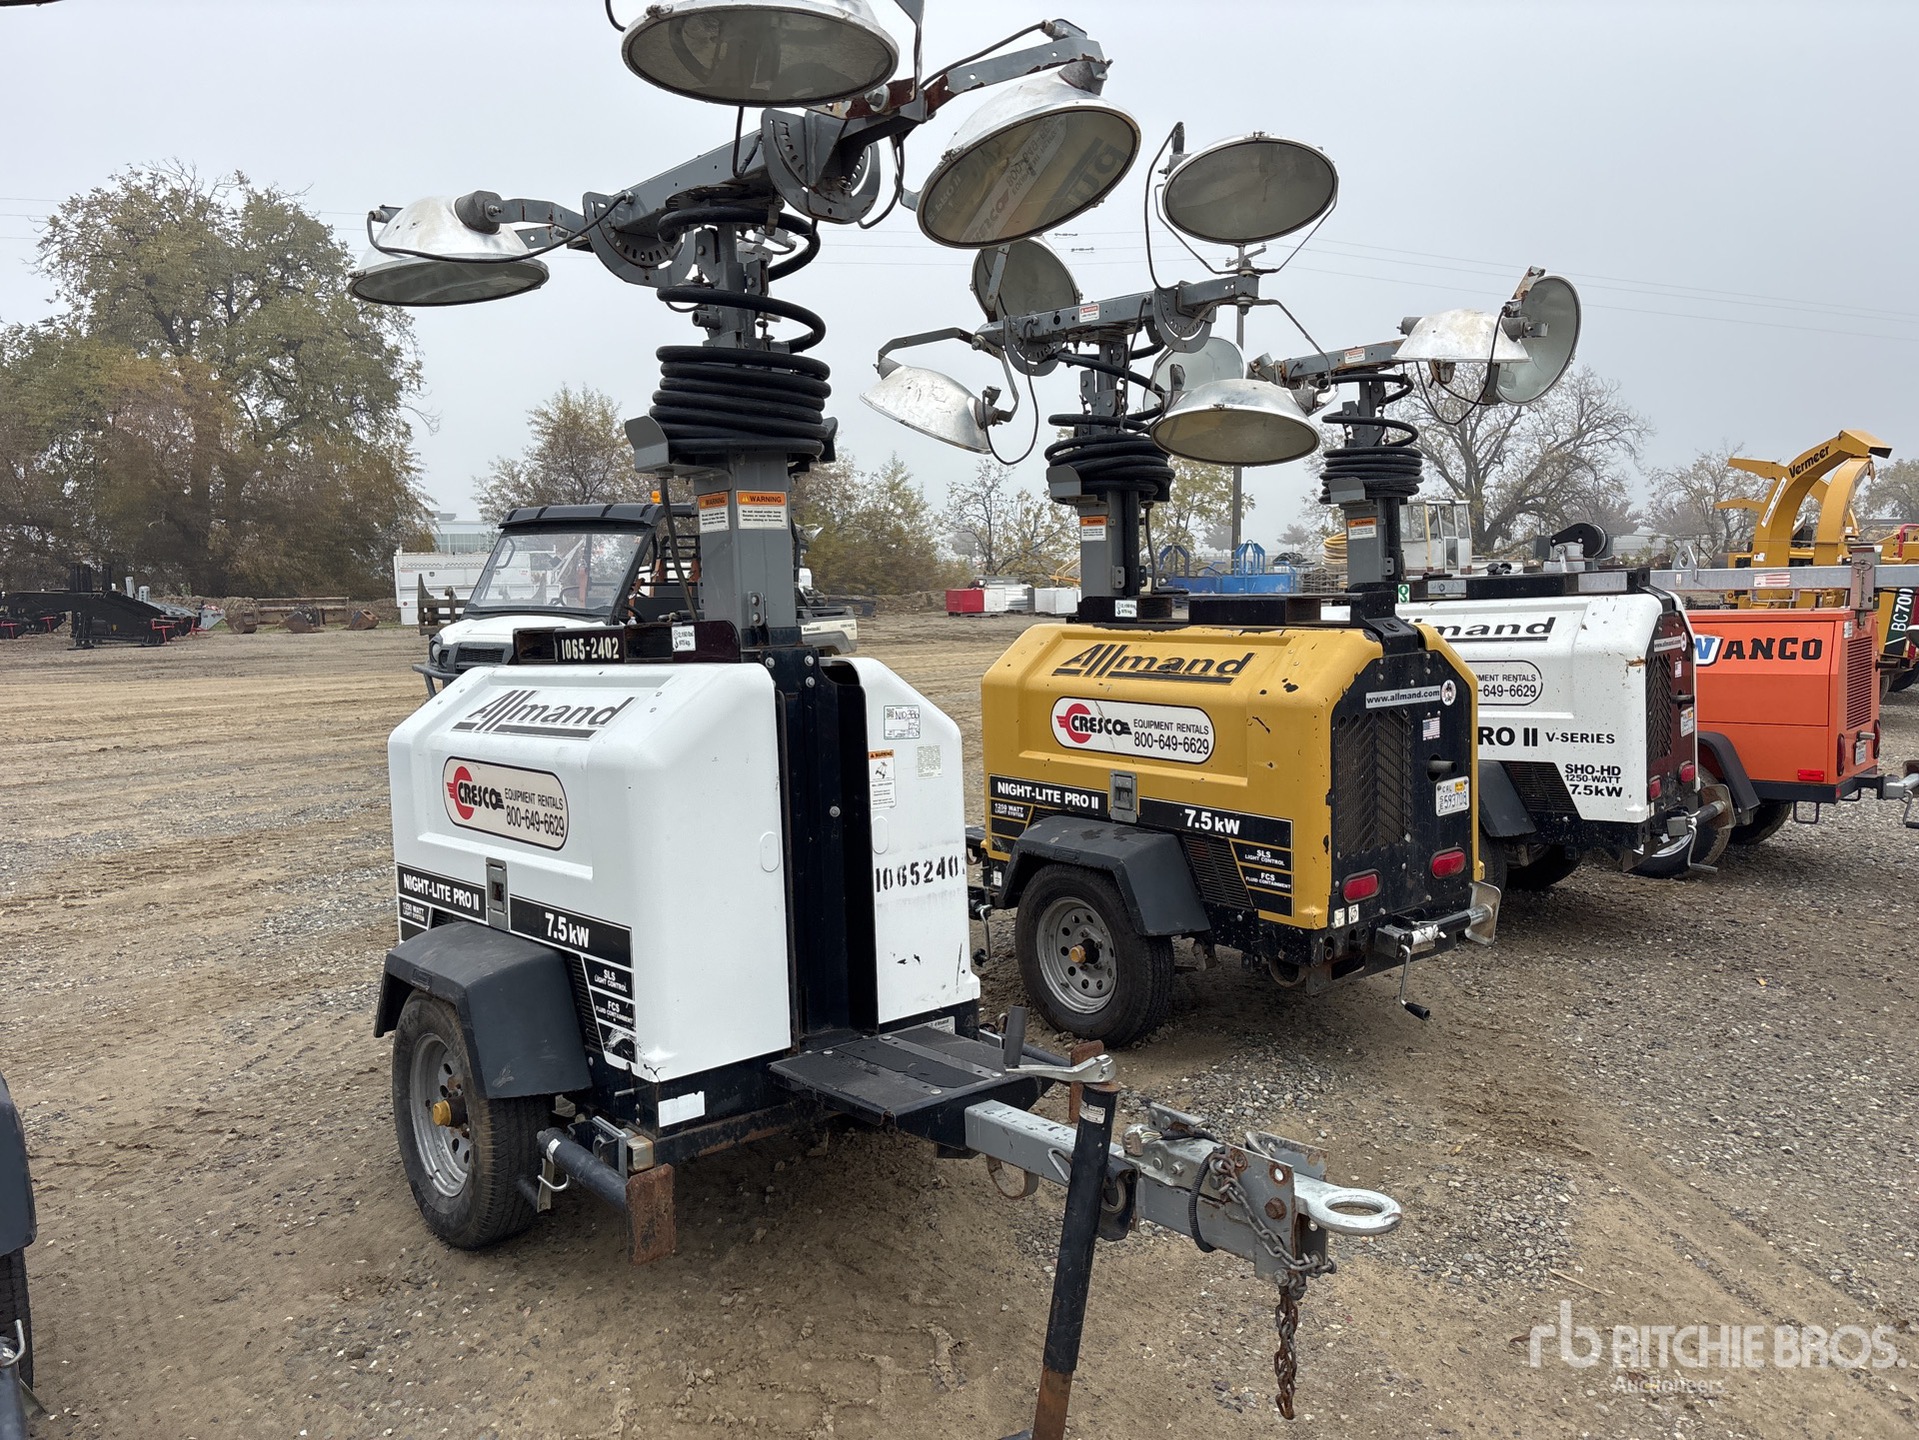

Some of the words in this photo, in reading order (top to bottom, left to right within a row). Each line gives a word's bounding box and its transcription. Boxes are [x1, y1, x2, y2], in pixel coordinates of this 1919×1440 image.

[1788, 444, 1831, 479] Vermeer
[749, 495, 782, 503] WARNING
[1404, 617, 1556, 637] mand
[561, 636, 620, 661] 1065-2402
[1060, 643, 1257, 678] Allmand
[1477, 674, 1499, 682] MENT
[1502, 674, 1536, 682] RENTALS
[1366, 690, 1440, 704] www.allmand.com
[1478, 684, 1537, 697] -649-6629
[467, 689, 636, 732] Allmand
[1071, 714, 1126, 736] CRESCO
[1133, 718, 1174, 732] EQUIPMENT
[1176, 722, 1209, 736] RENTALS
[1133, 732, 1209, 755] 800-649-6629
[1478, 726, 1516, 746] RO
[1523, 727, 1538, 747] II
[1545, 732, 1616, 744] V-SERIES
[1564, 763, 1622, 776] SHO-HD
[1564, 774, 1621, 784] 1250-WATT
[457, 781, 500, 811] CRESCO
[504, 787, 536, 805] EQUIPMENT
[537, 794, 564, 811] RENTALS
[997, 781, 1061, 803] NIGHT-LITE
[1064, 792, 1089, 808] PRO
[1091, 796, 1099, 810] II
[1569, 784, 1623, 798] 7.5kW
[505, 807, 565, 838] 800-649-6629
[1184, 808, 1212, 831] 7.5
[1214, 815, 1240, 836] kW
[1256, 849, 1271, 858] SLS
[1260, 857, 1285, 866] CONTROL
[876, 855, 965, 893] 1065240
[1260, 872, 1275, 882] FCS
[403, 872, 451, 903] NIGHT-LITE
[453, 887, 472, 909] PRO
[473, 893, 480, 911] II
[545, 912, 567, 942] 7.5
[569, 925, 589, 948] kW
[594, 974, 607, 985] LIGHT
[607, 980, 628, 993] CONTROL
[603, 969, 616, 981] SLS
[607, 1000, 620, 1013] FCS
